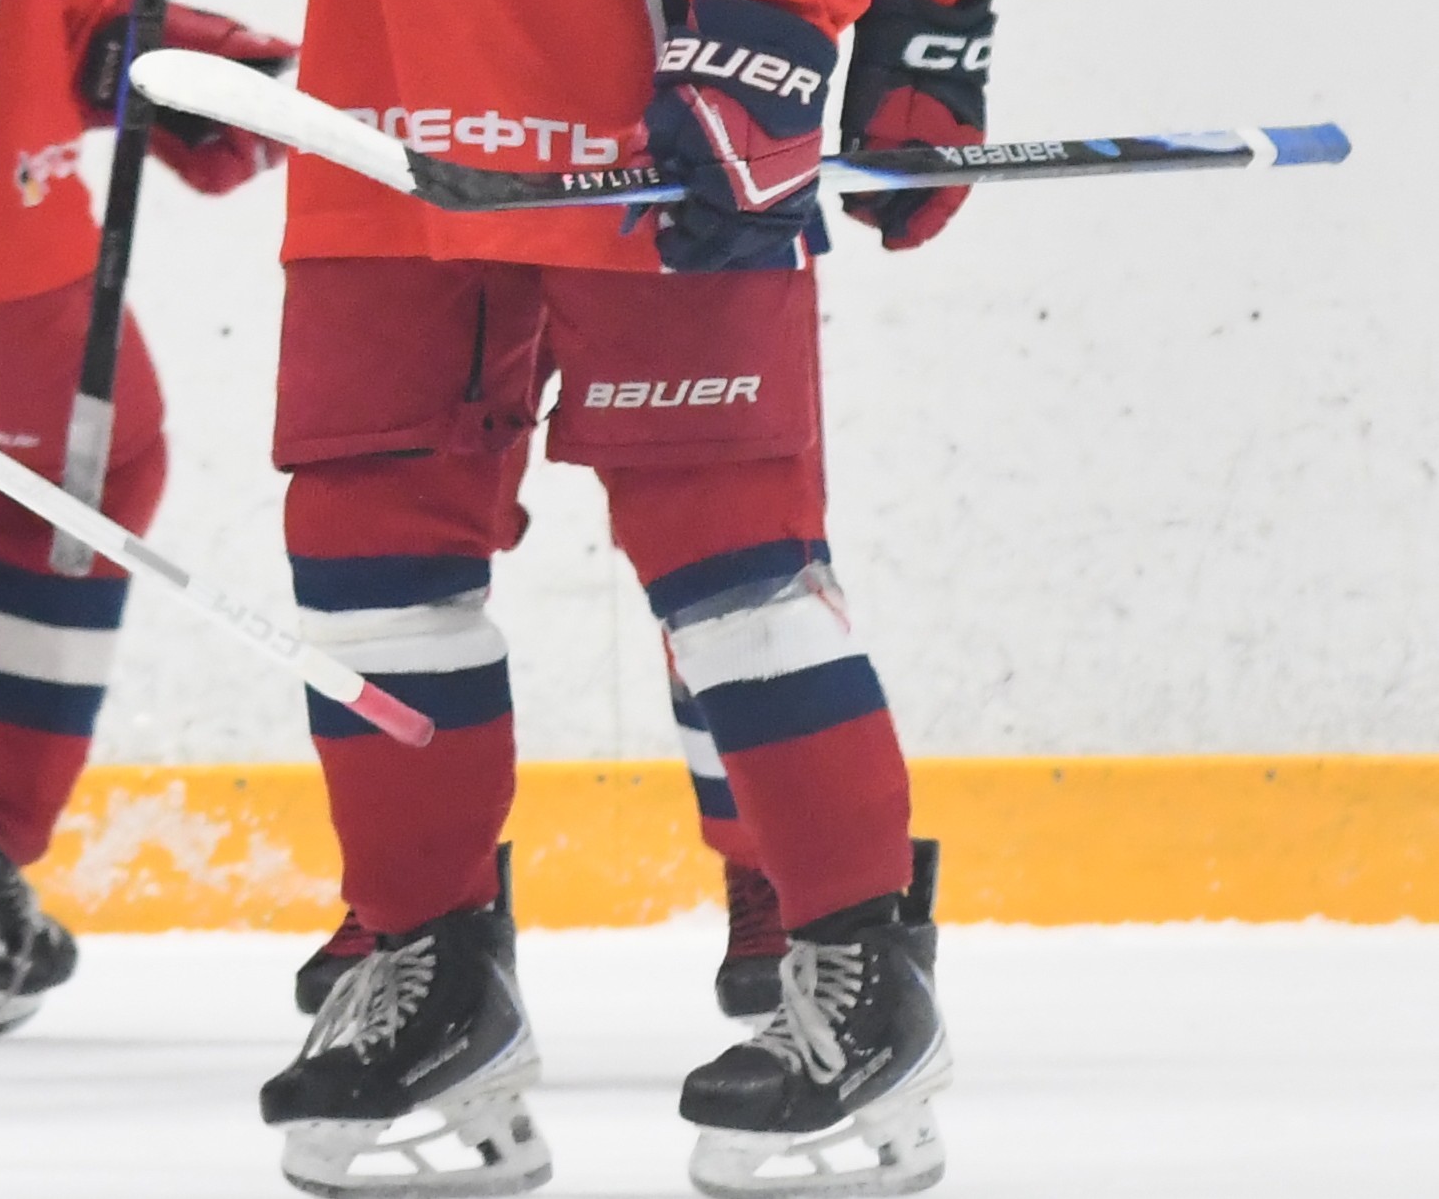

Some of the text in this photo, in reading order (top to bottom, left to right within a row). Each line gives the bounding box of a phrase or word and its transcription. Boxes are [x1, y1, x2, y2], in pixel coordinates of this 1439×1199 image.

[903, 33, 993, 72] CC
[656, 37, 822, 105] AUER
[562, 166, 661, 191] FLYLITE
[583, 374, 762, 408] BAUER
